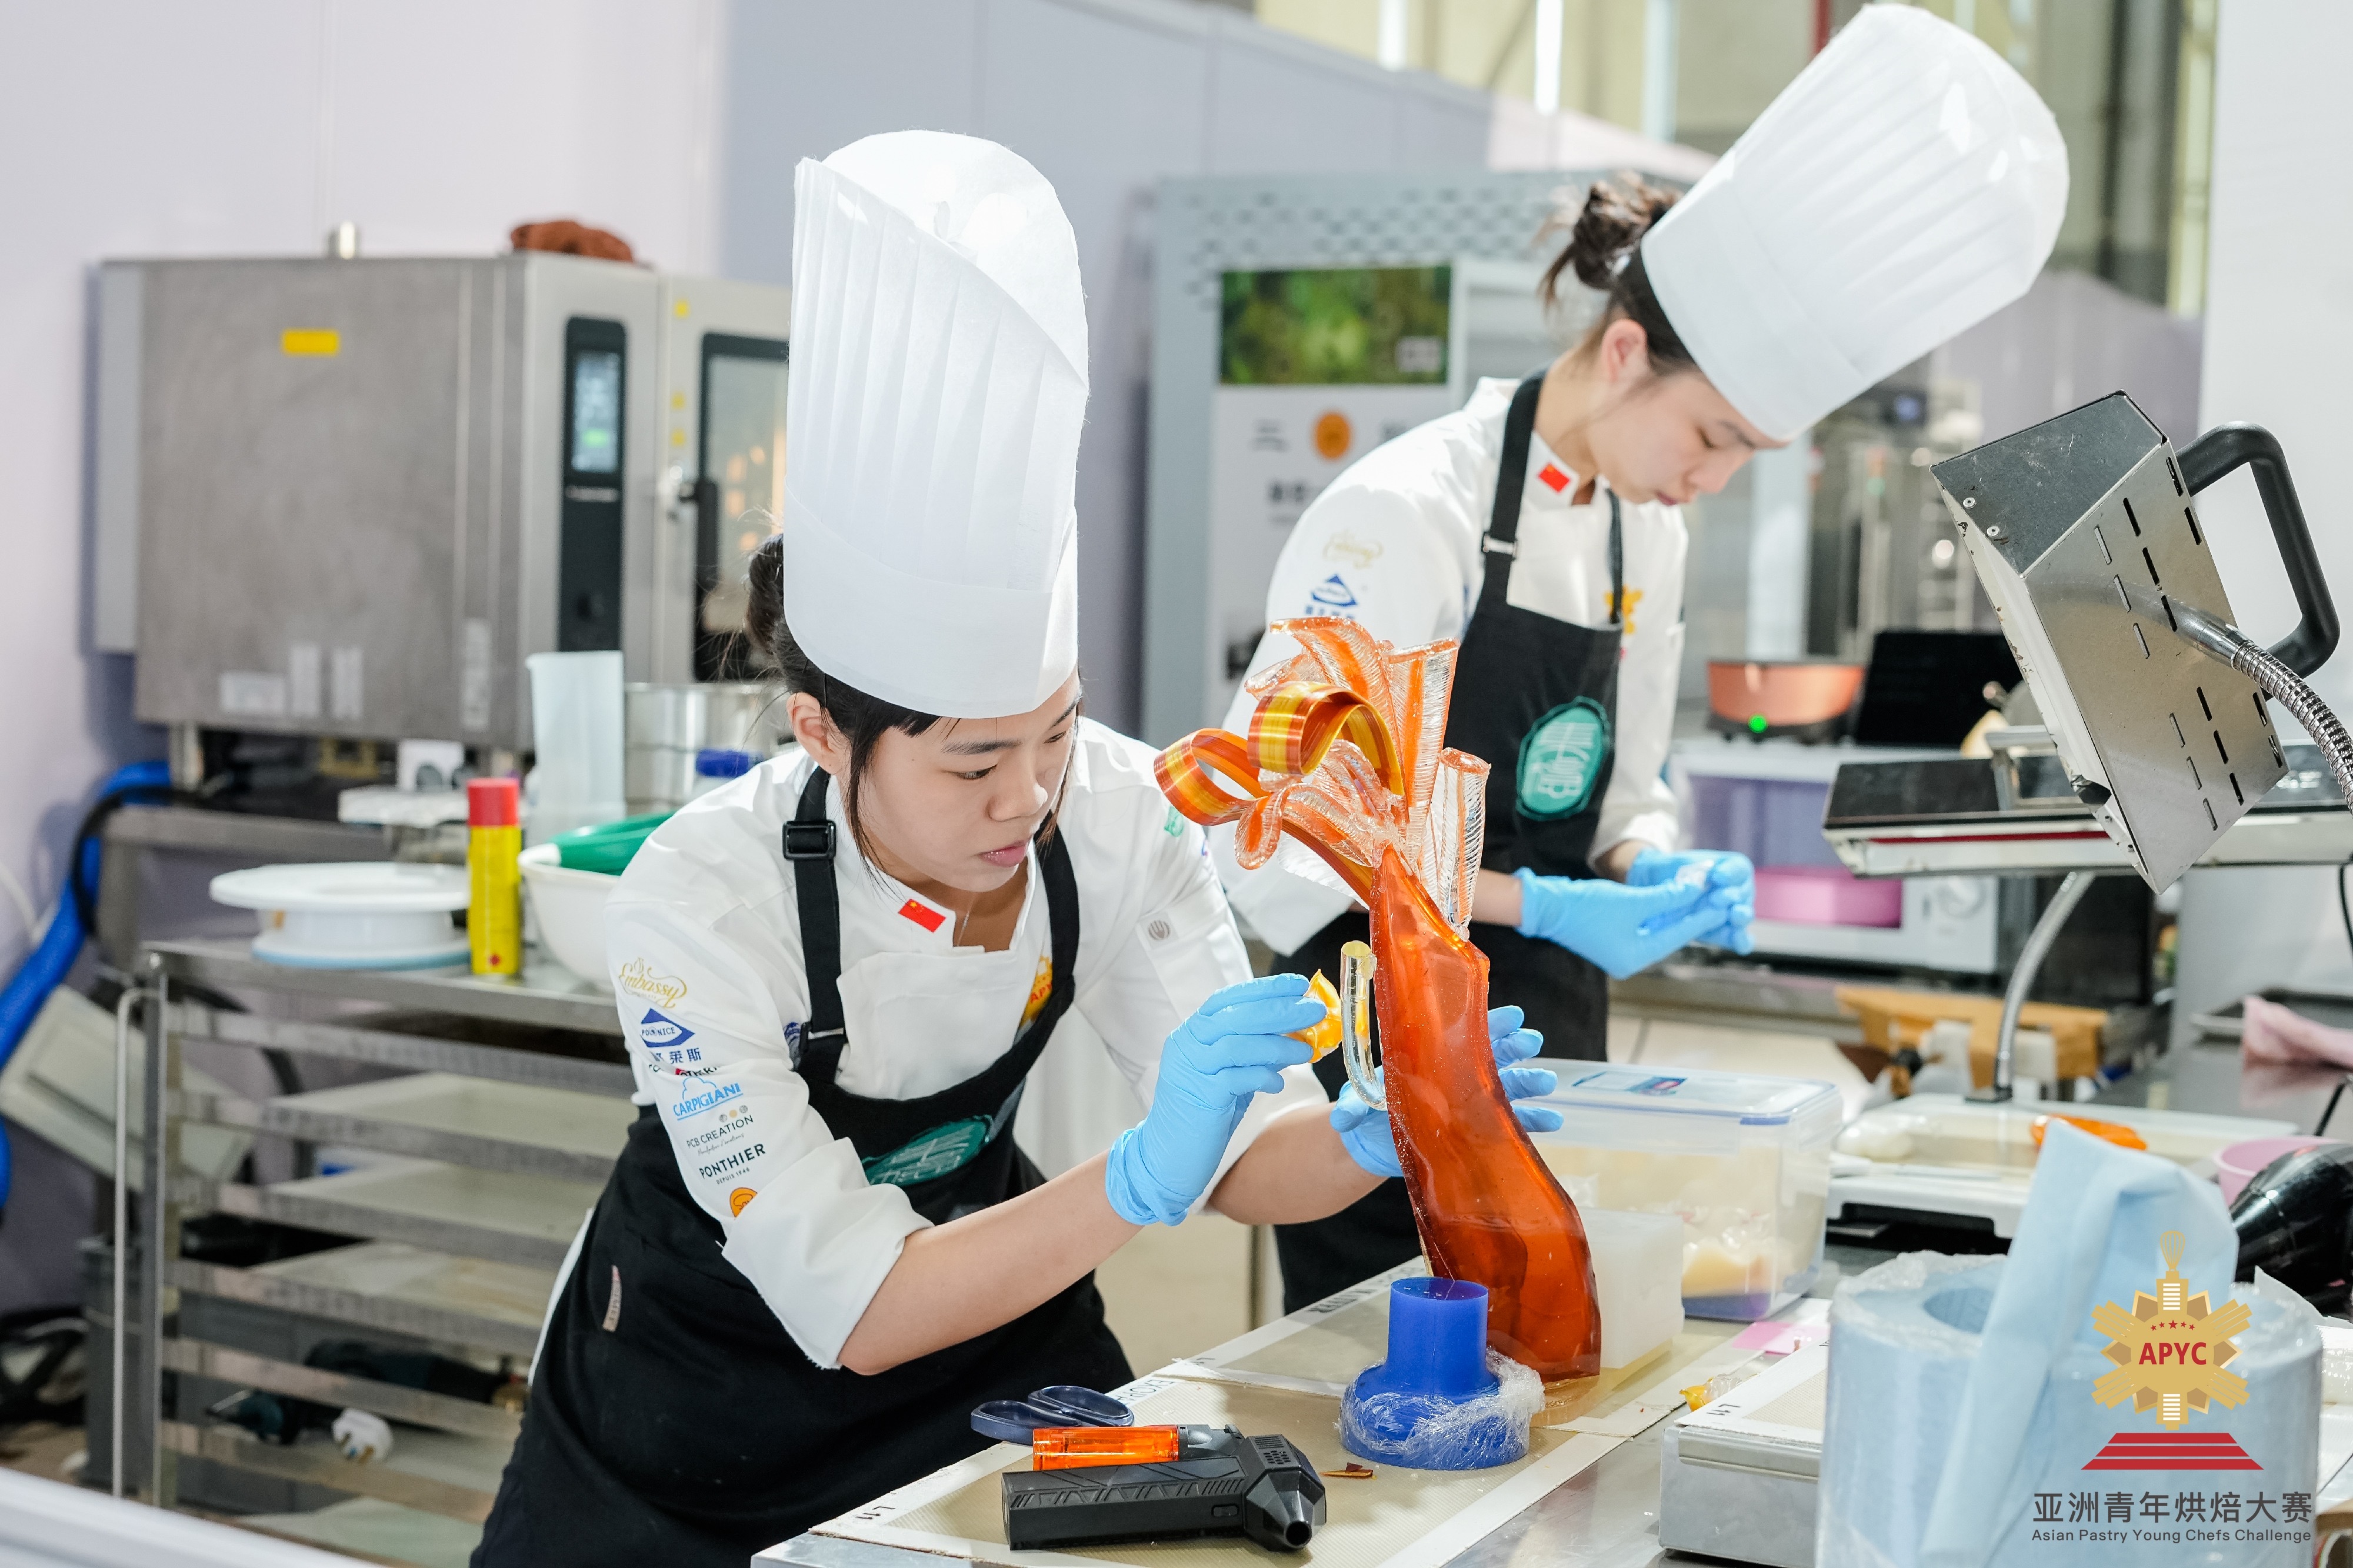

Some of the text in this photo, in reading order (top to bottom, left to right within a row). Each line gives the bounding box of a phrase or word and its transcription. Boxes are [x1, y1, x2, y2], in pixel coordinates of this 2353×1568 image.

[619, 963, 687, 1008] Embassy
[673, 1082, 741, 1116] CARPIGIANI
[686, 1137, 700, 1149] PCB
[701, 1115, 754, 1144] CREATION
[699, 1143, 766, 1179] PONTHIER
[716, 1174, 735, 1185] DEPUIS
